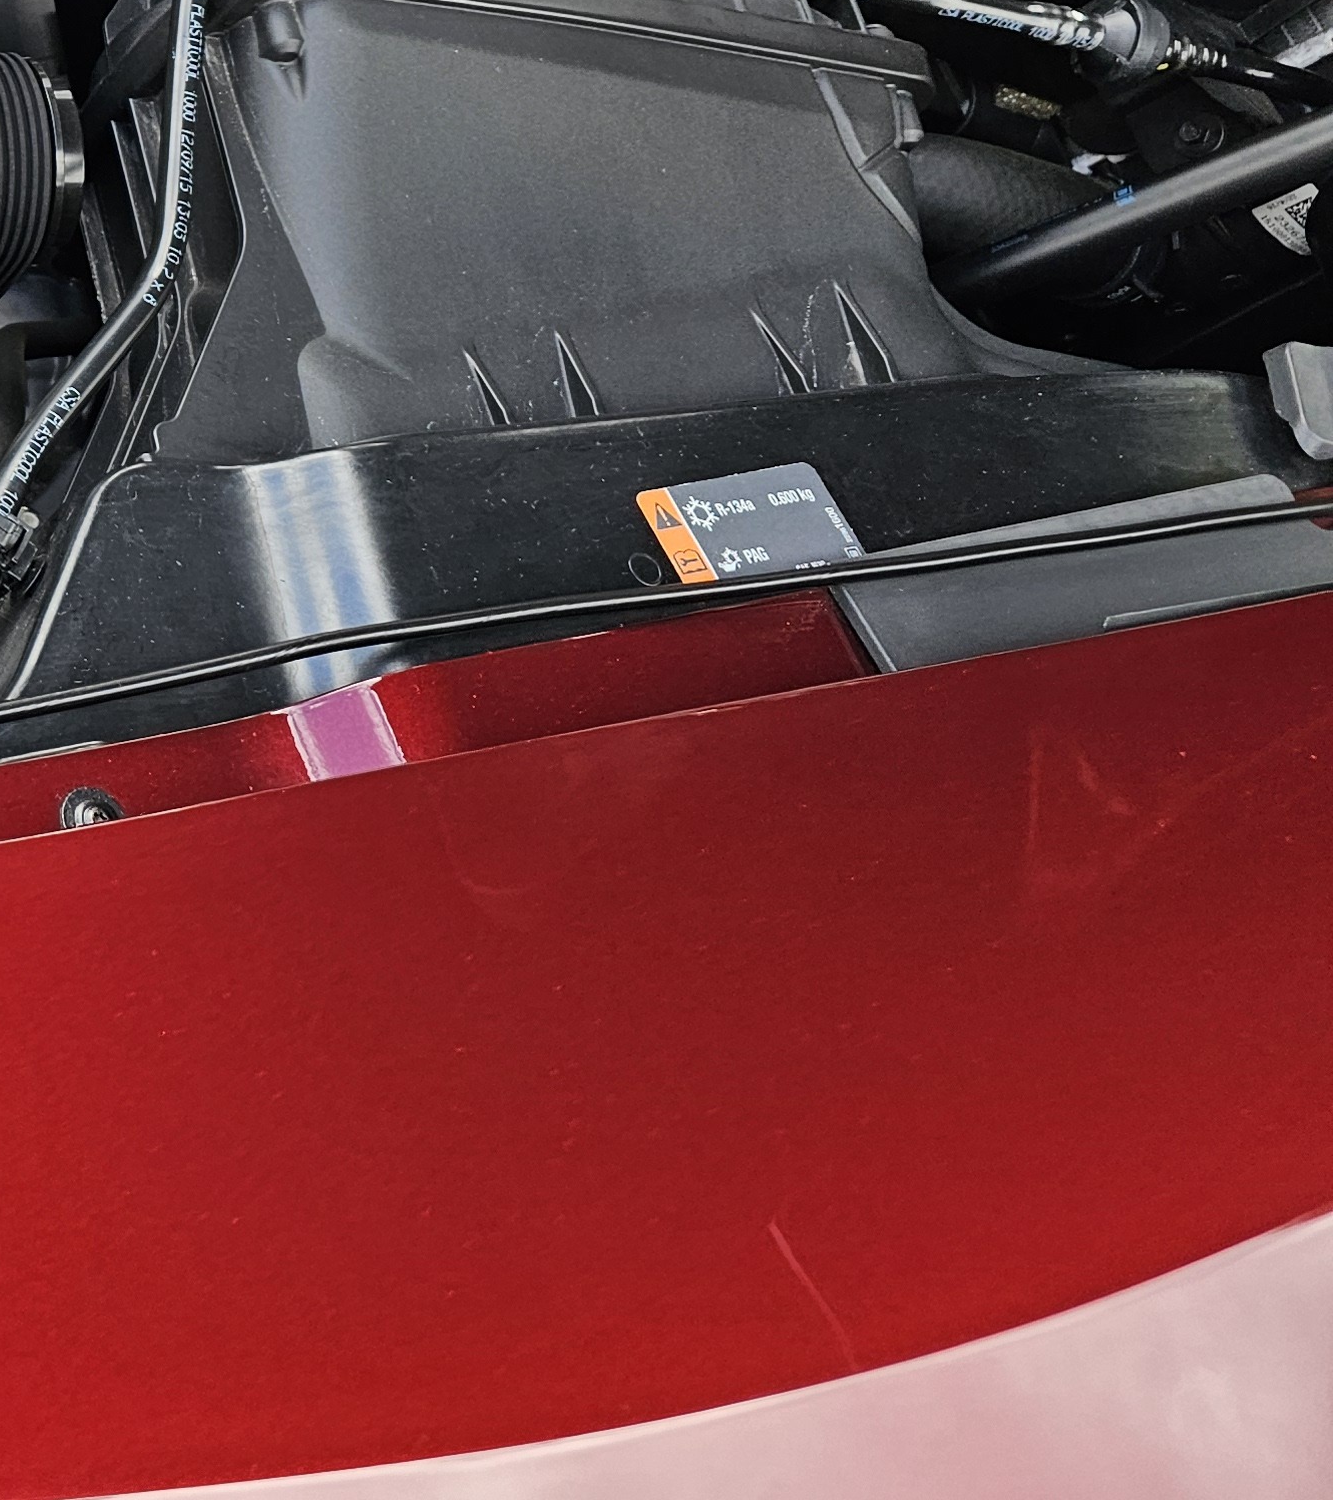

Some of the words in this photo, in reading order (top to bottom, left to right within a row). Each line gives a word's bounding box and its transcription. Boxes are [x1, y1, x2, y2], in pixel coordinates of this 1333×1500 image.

[179, 128, 195, 195] 12/09/15
[163, 246, 183, 280] 10.2
[714, 498, 757, 518] R-134a
[767, 489, 799, 507] 0.600
[796, 487, 817, 502] kg
[742, 545, 771, 565] PAG
